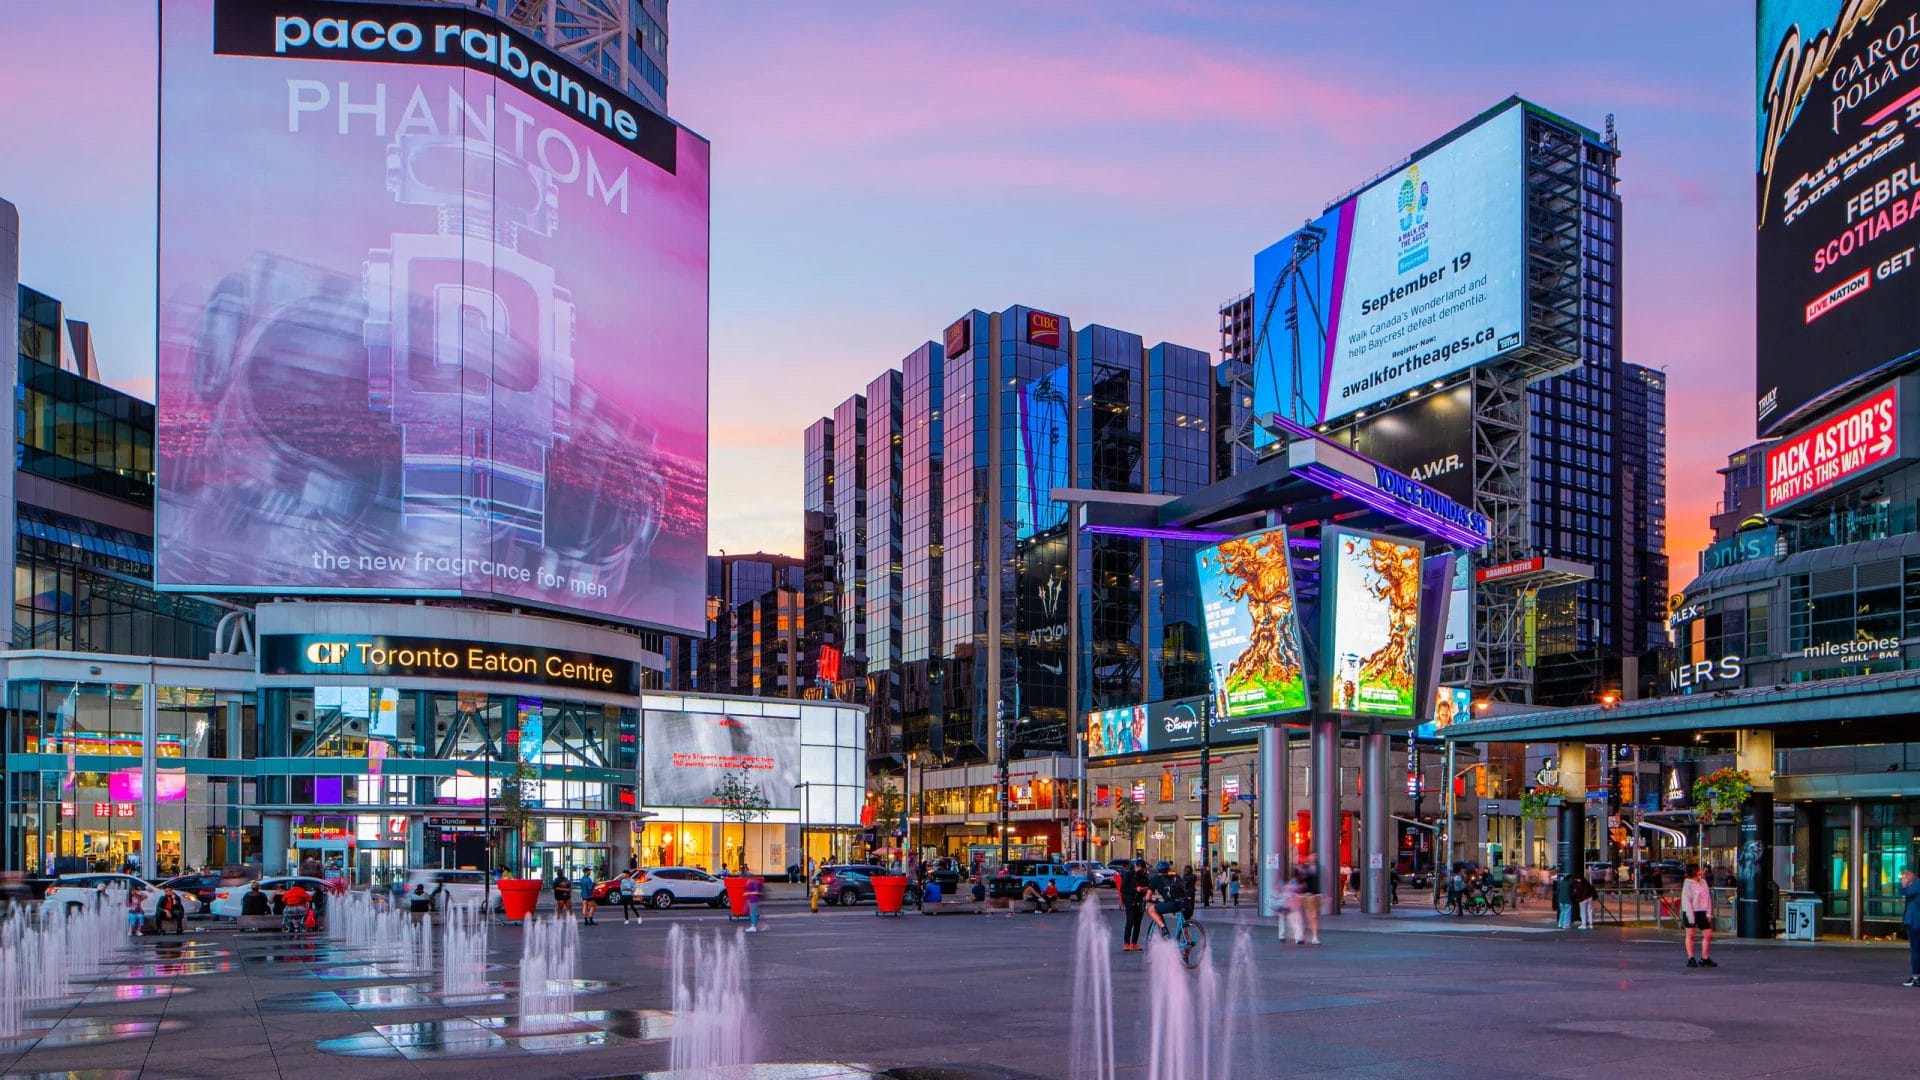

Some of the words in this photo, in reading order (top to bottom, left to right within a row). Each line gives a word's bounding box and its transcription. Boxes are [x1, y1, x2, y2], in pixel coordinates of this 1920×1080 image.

[274, 15, 423, 53] paco
[435, 23, 639, 141] rabanne
[286, 78, 629, 214] PHANTOM
[1784, 119, 1899, 213] Future
[1784, 176, 1841, 226] TOUR
[1843, 133, 1905, 181] 2022
[1401, 238, 1411, 248] THE
[1412, 231, 1425, 242] AGES
[1361, 265, 1446, 316] September
[1451, 251, 1472, 274] 19
[1877, 247, 1915, 279] GET
[1349, 329, 1368, 345] Walk
[1370, 311, 1409, 333] Canada's
[1410, 285, 1466, 317] Wonderland
[1468, 274, 1487, 291] and
[1809, 298, 1828, 317] LIVE
[1829, 276, 1866, 305] NATION
[1032, 314, 1058, 330] CIBC
[1348, 344, 1367, 360] help
[1369, 326, 1405, 351] Baycrest
[1408, 316, 1436, 333] defeat
[1439, 292, 1488, 320] dementia.
[1342, 326, 1495, 399] awalkfortheages.ca
[1392, 343, 1419, 360] Register
[1421, 336, 1437, 347] Now:
[1758, 387, 1778, 411] TRULY
[1770, 438, 1811, 486] JACK
[1814, 398, 1893, 465] ASTOR'S
[1410, 454, 1464, 481] A.W.R.
[1770, 475, 1802, 506] PARTY
[1803, 470, 1814, 491] IS
[1815, 457, 1840, 485] THIS
[1841, 444, 1868, 473] WAY
[311, 550, 351, 570] the
[359, 552, 406, 570] new
[414, 552, 531, 583] fragrance
[537, 567, 565, 588] for
[571, 577, 608, 598] men
[1485, 565, 1512, 578] BRANDED
[1513, 561, 1532, 573] CITIES
[307, 642, 350, 665] CF
[356, 643, 458, 668] Toronto
[468, 648, 537, 674] Eaton
[546, 656, 614, 684] Centre
[1803, 637, 1899, 658] milestones
[1841, 653, 1869, 663] GRILL
[1879, 650, 1900, 659] BAR
